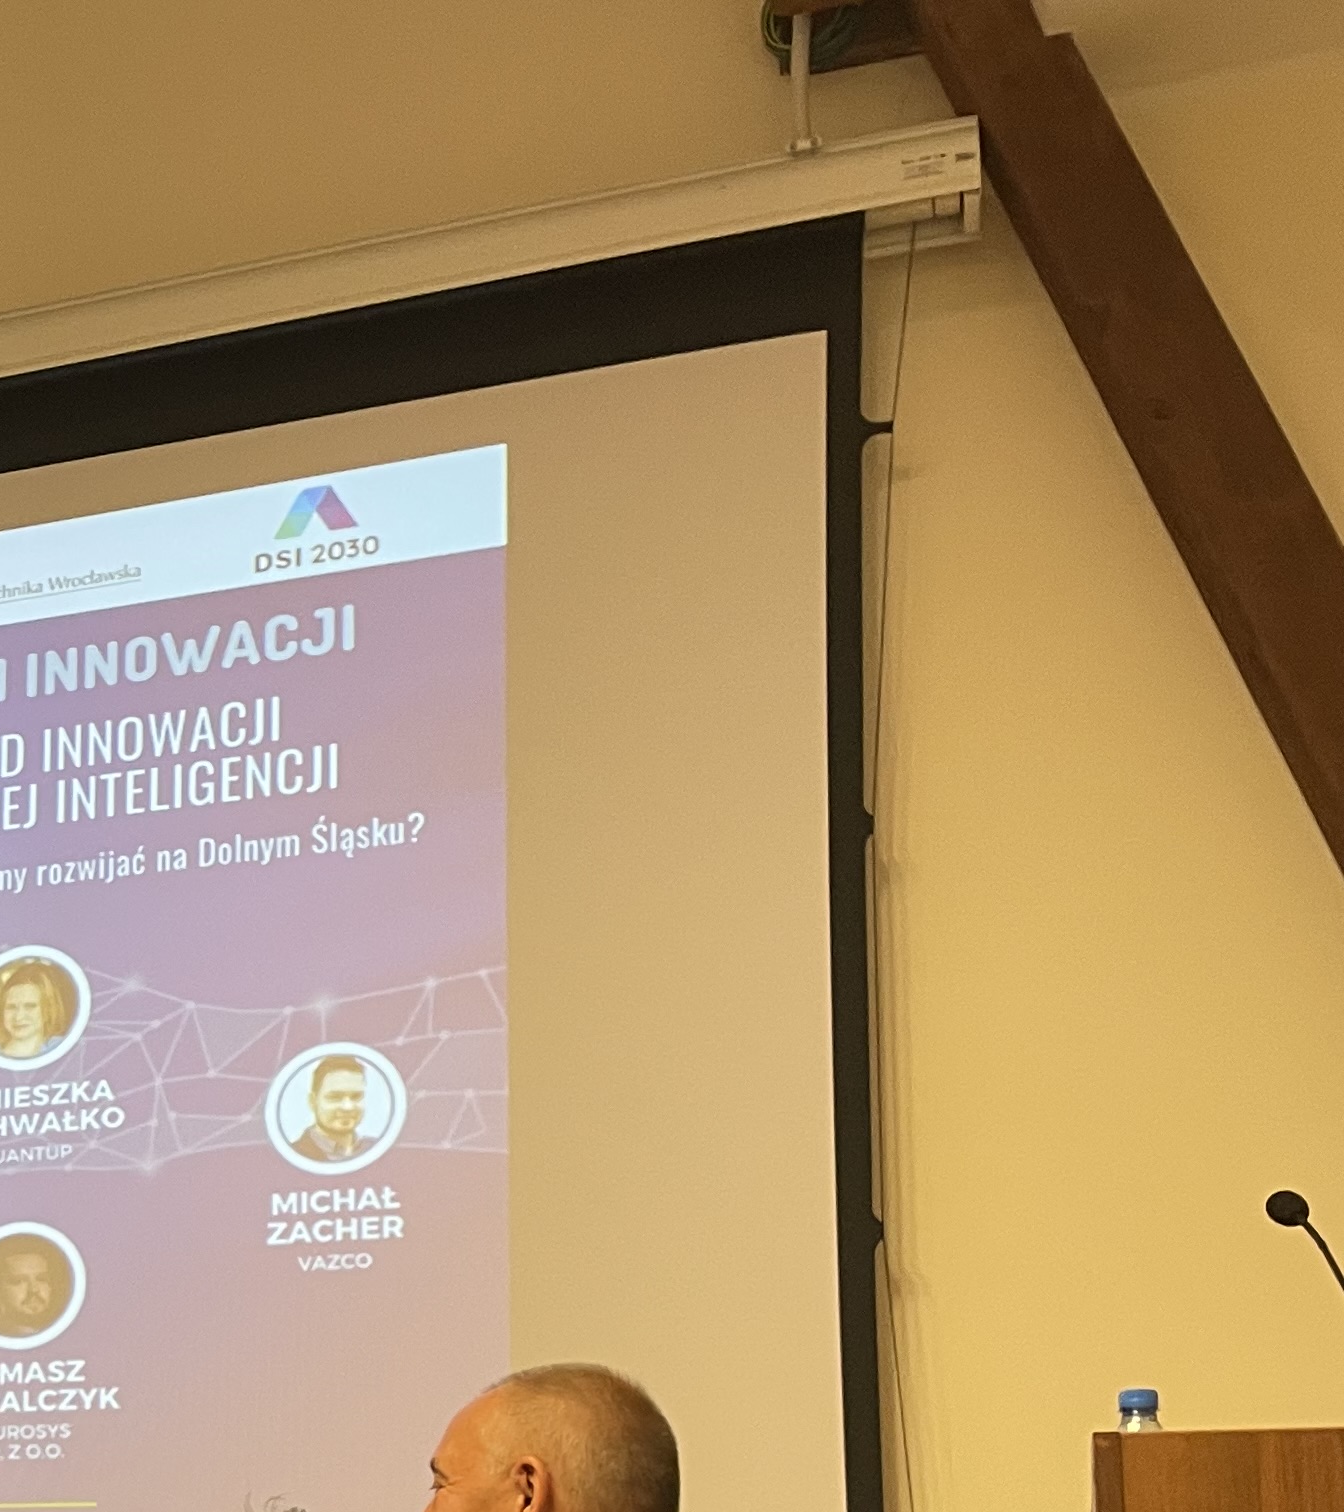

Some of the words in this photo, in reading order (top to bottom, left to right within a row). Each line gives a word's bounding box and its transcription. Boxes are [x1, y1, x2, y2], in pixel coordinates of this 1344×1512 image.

[254, 547, 302, 574] DSI
[311, 535, 381, 567] 2030
[49, 564, 141, 591] Wrocławska
[25, 604, 356, 698] INNOWACJI
[42, 696, 281, 774] INNOWACJI
[55, 743, 339, 824] INTELIGENCJI
[37, 845, 146, 890] rozwijać
[156, 847, 188, 872] na
[197, 831, 301, 869] Dolnym
[311, 811, 425, 858] Śląsku?
[270, 1186, 401, 1218] MICHAŁ
[266, 1215, 405, 1247] ZACHER
[297, 1252, 373, 1272] VAZCO
[9, 1444, 22, 1460] Z
